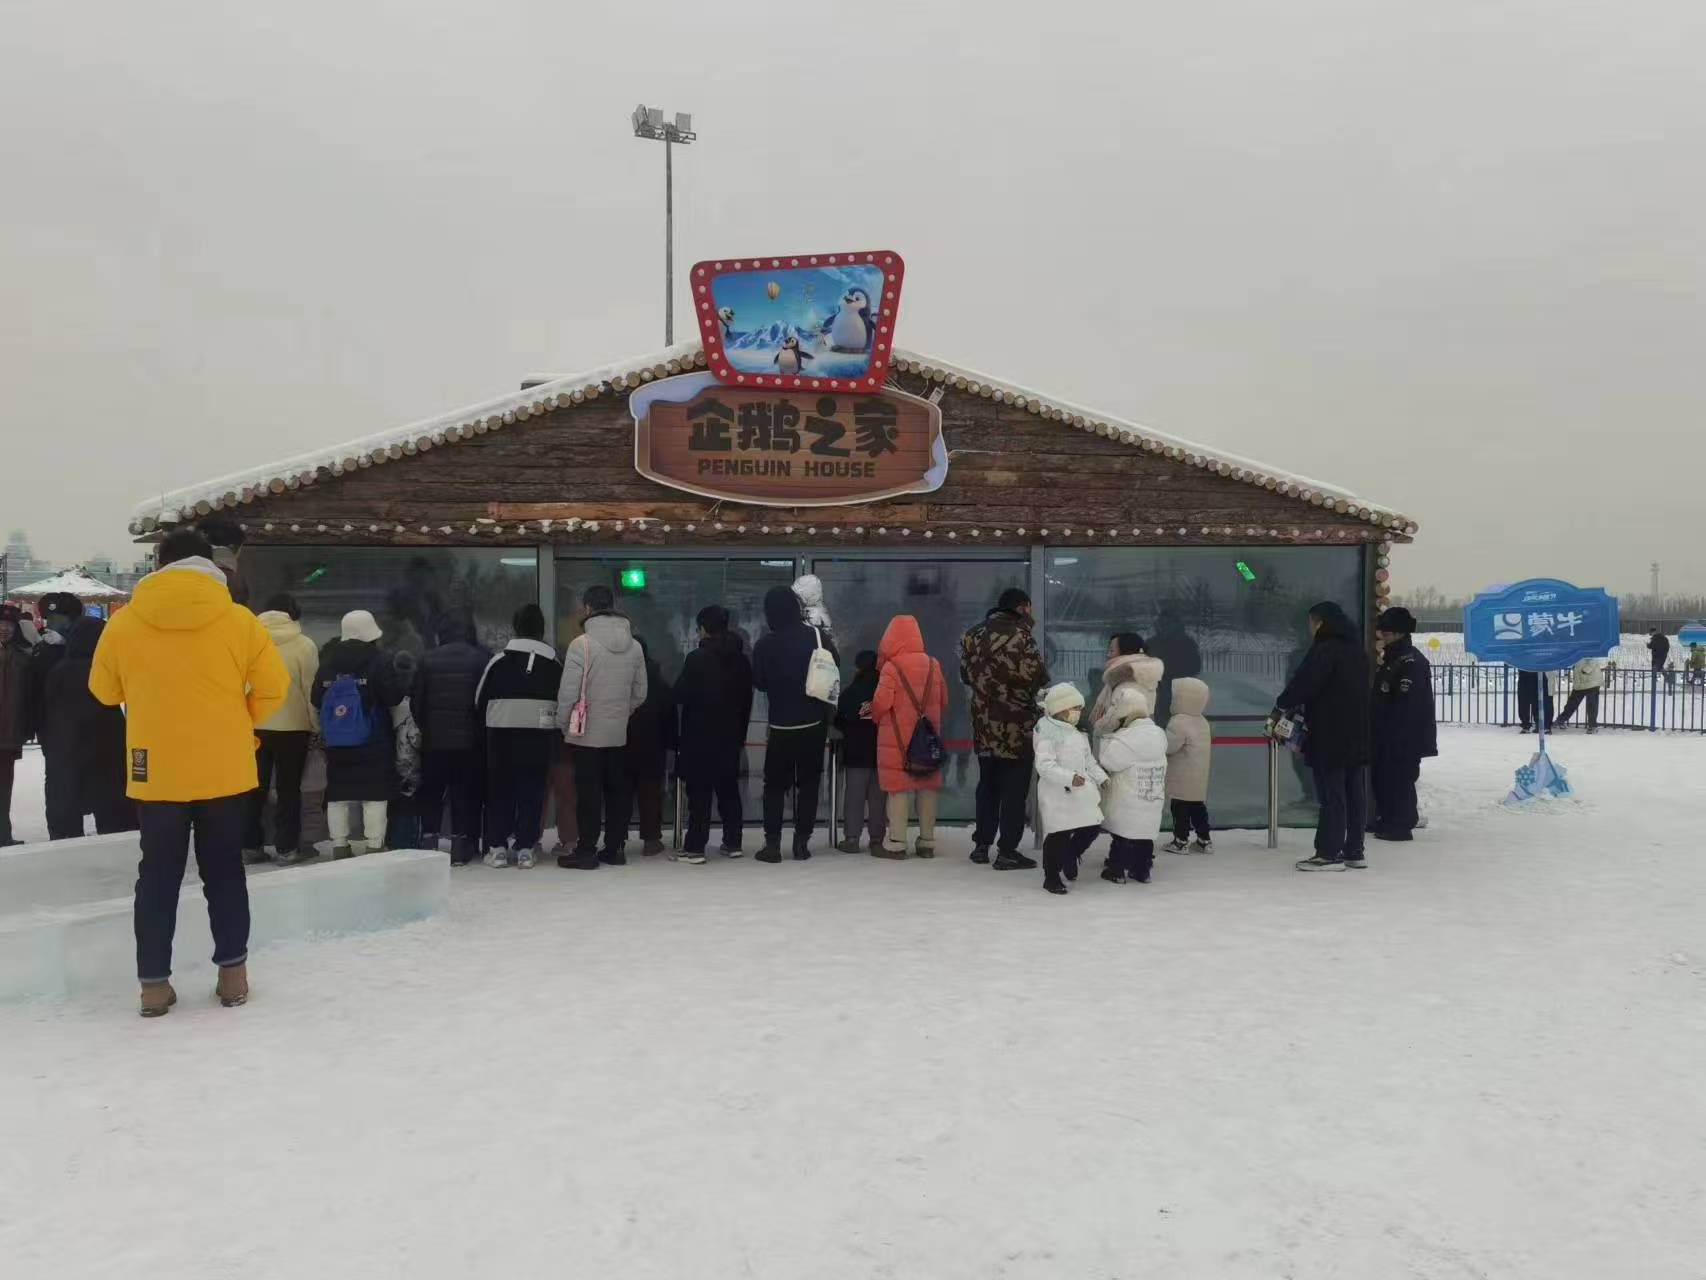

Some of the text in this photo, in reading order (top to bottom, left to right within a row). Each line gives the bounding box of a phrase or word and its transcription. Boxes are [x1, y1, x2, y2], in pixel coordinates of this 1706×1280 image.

[687, 397, 898, 458] 企鹅之家
[698, 458, 876, 478] PENGUIN HOUSE
[1528, 612, 1583, 637] 蒙牛
